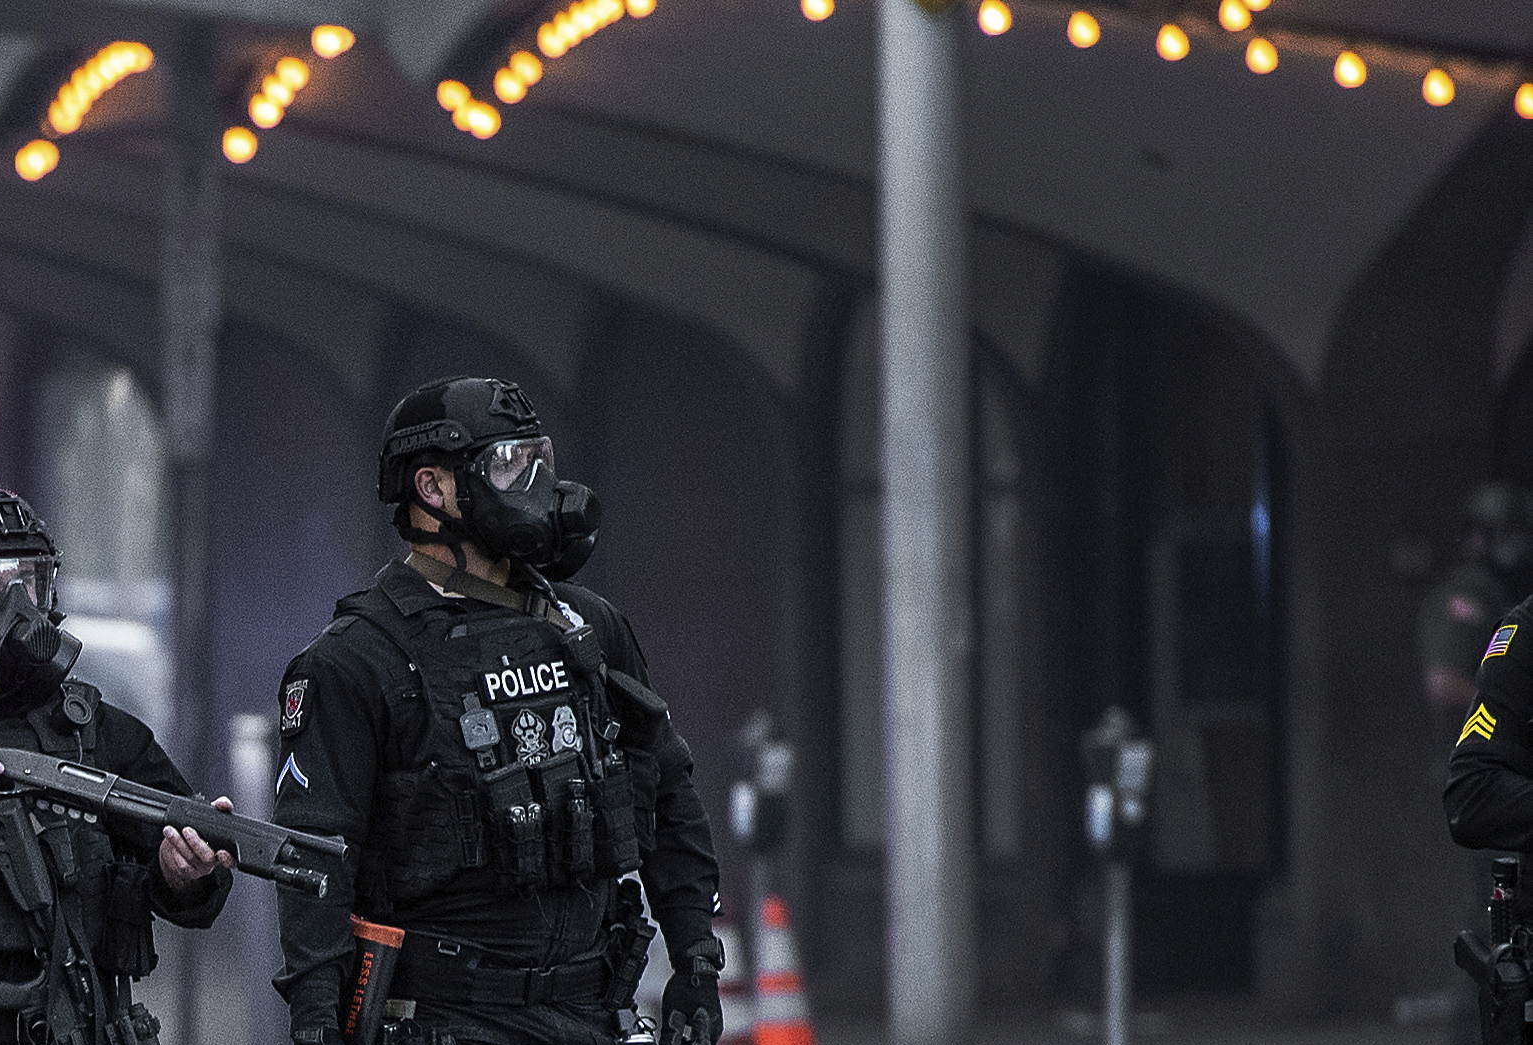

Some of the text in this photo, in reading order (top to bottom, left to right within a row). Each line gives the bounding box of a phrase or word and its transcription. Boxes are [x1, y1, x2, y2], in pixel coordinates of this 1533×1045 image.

[485, 660, 569, 700] POLICE
[282, 710, 303, 731] SWAT
[346, 951, 373, 1035] LESS LETHAL
